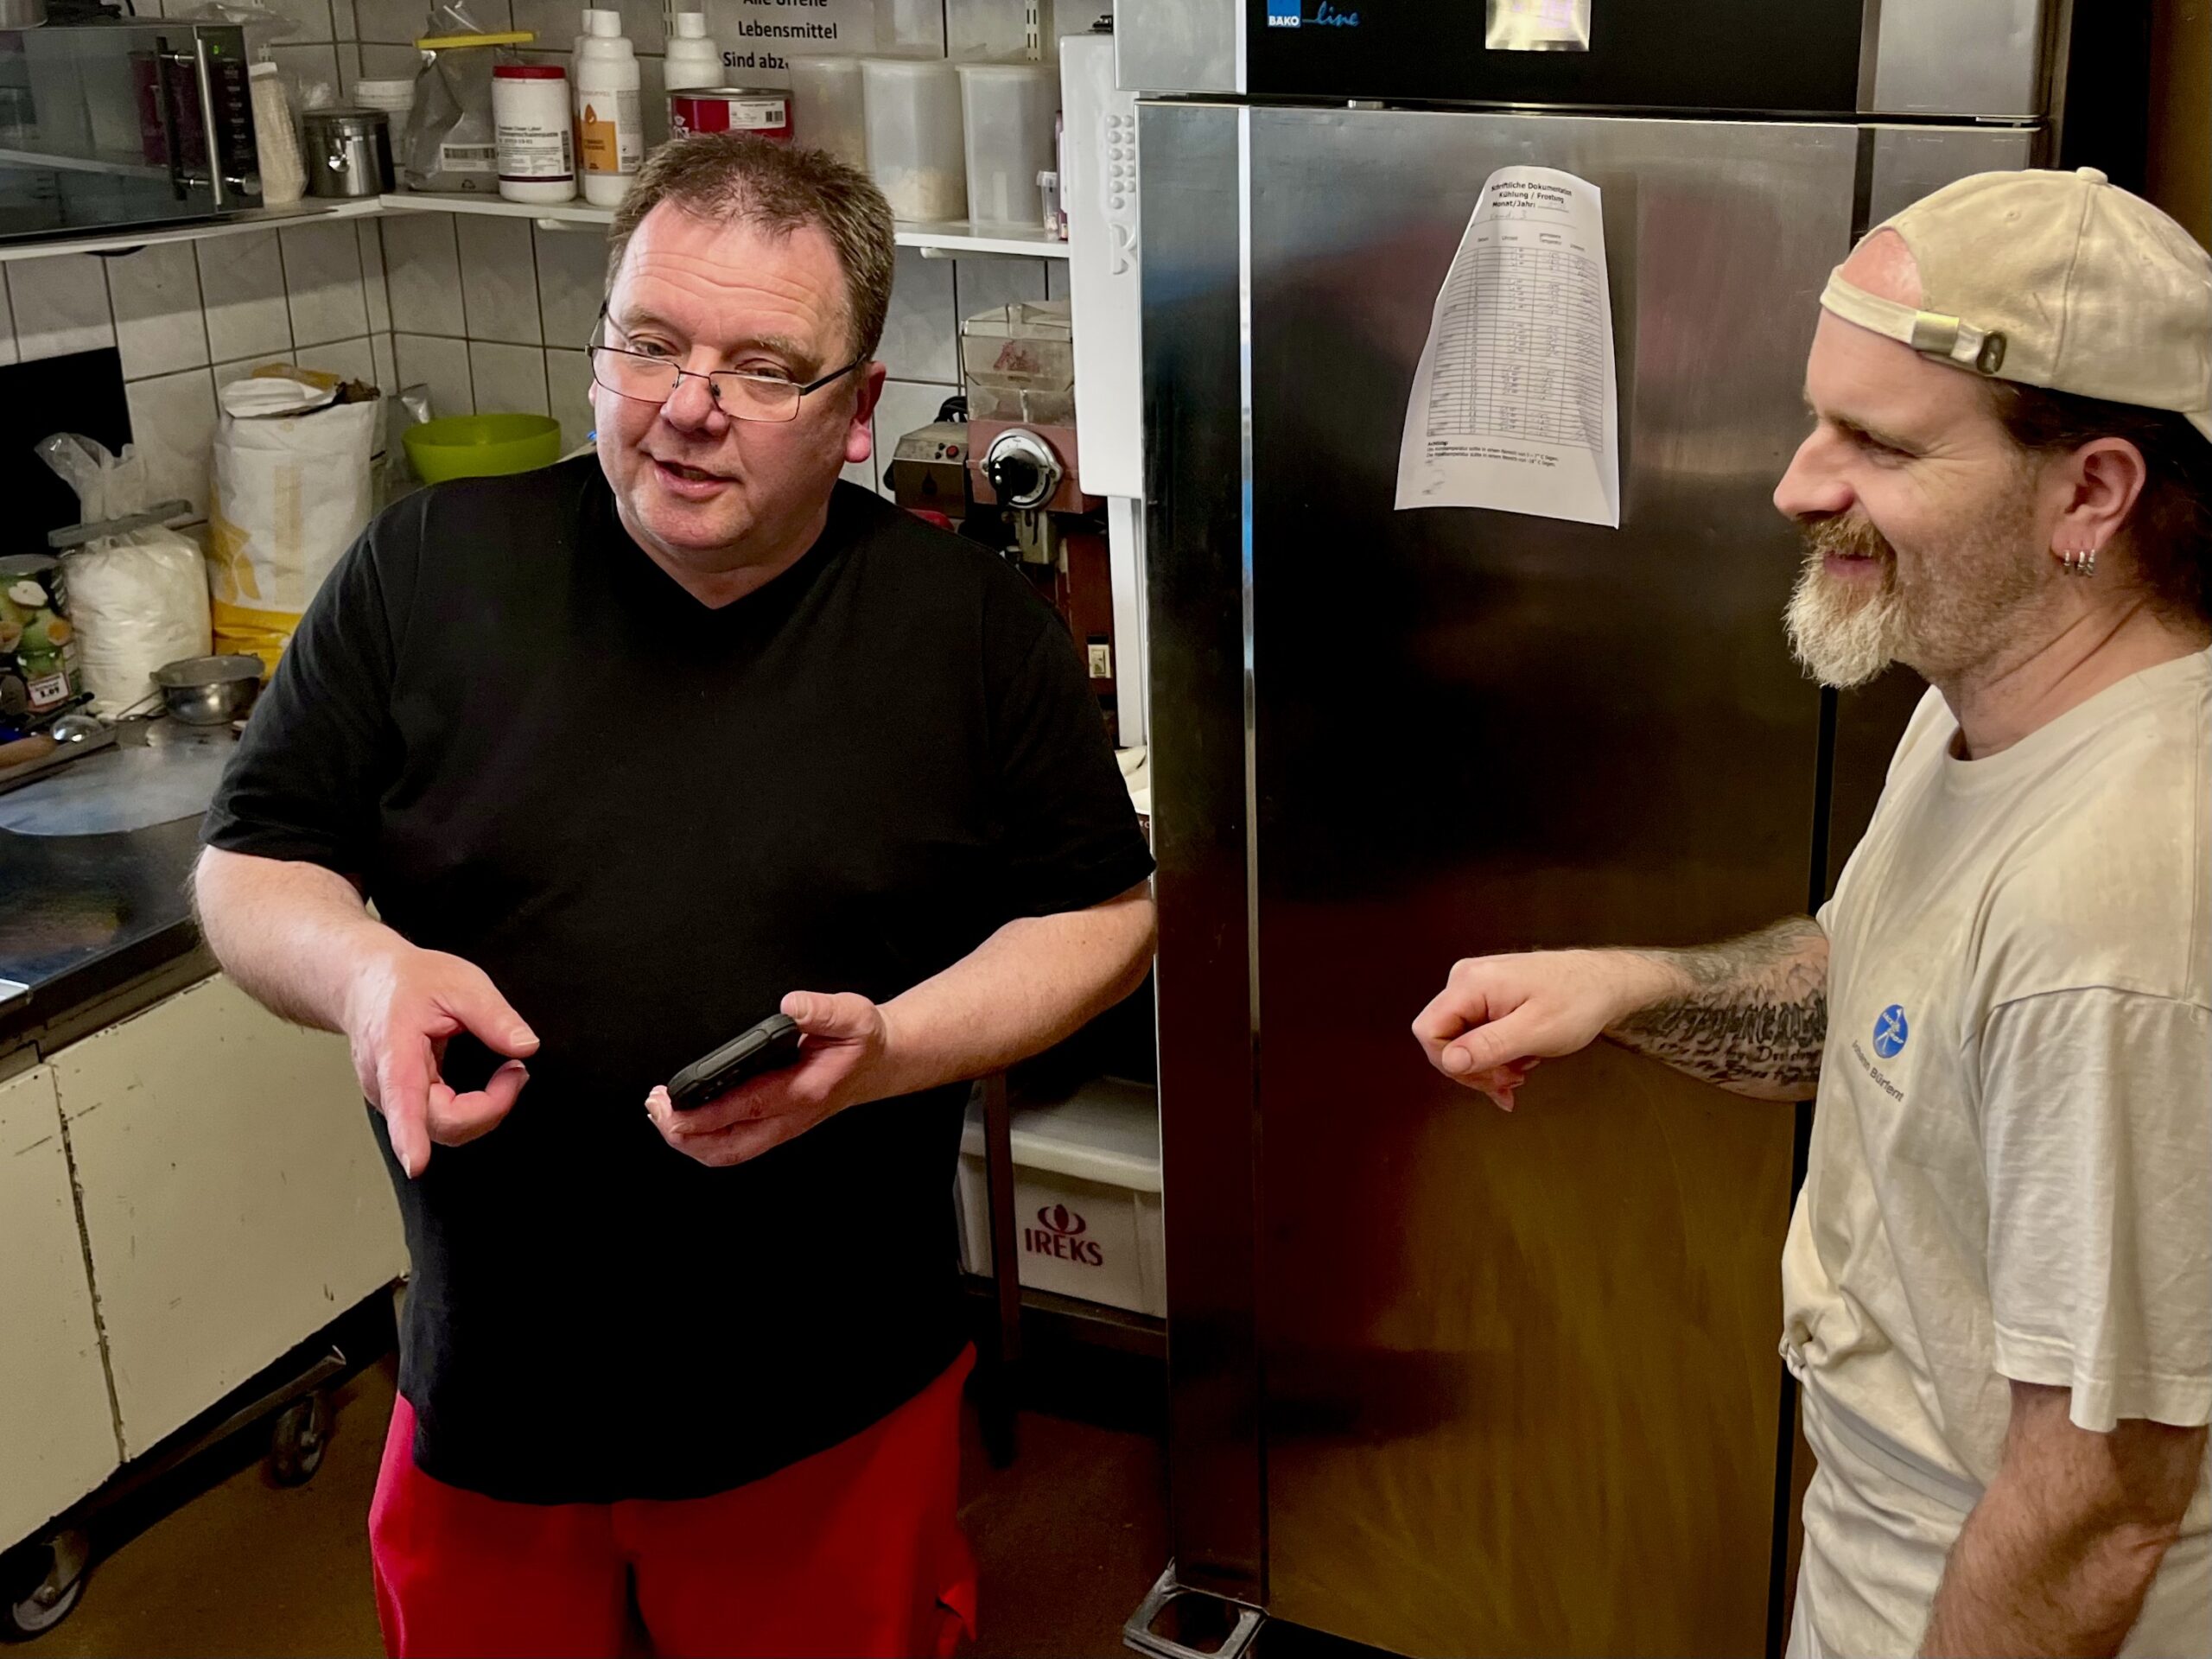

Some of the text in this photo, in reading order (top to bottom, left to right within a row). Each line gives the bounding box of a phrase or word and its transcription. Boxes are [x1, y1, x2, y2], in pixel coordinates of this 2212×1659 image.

[739, 19, 837, 39] Lebensmittel
[723, 52, 754, 67] Sind
[1499, 191, 1529, 200] Kühlung
[1025, 1228, 1103, 1267] IREKS
